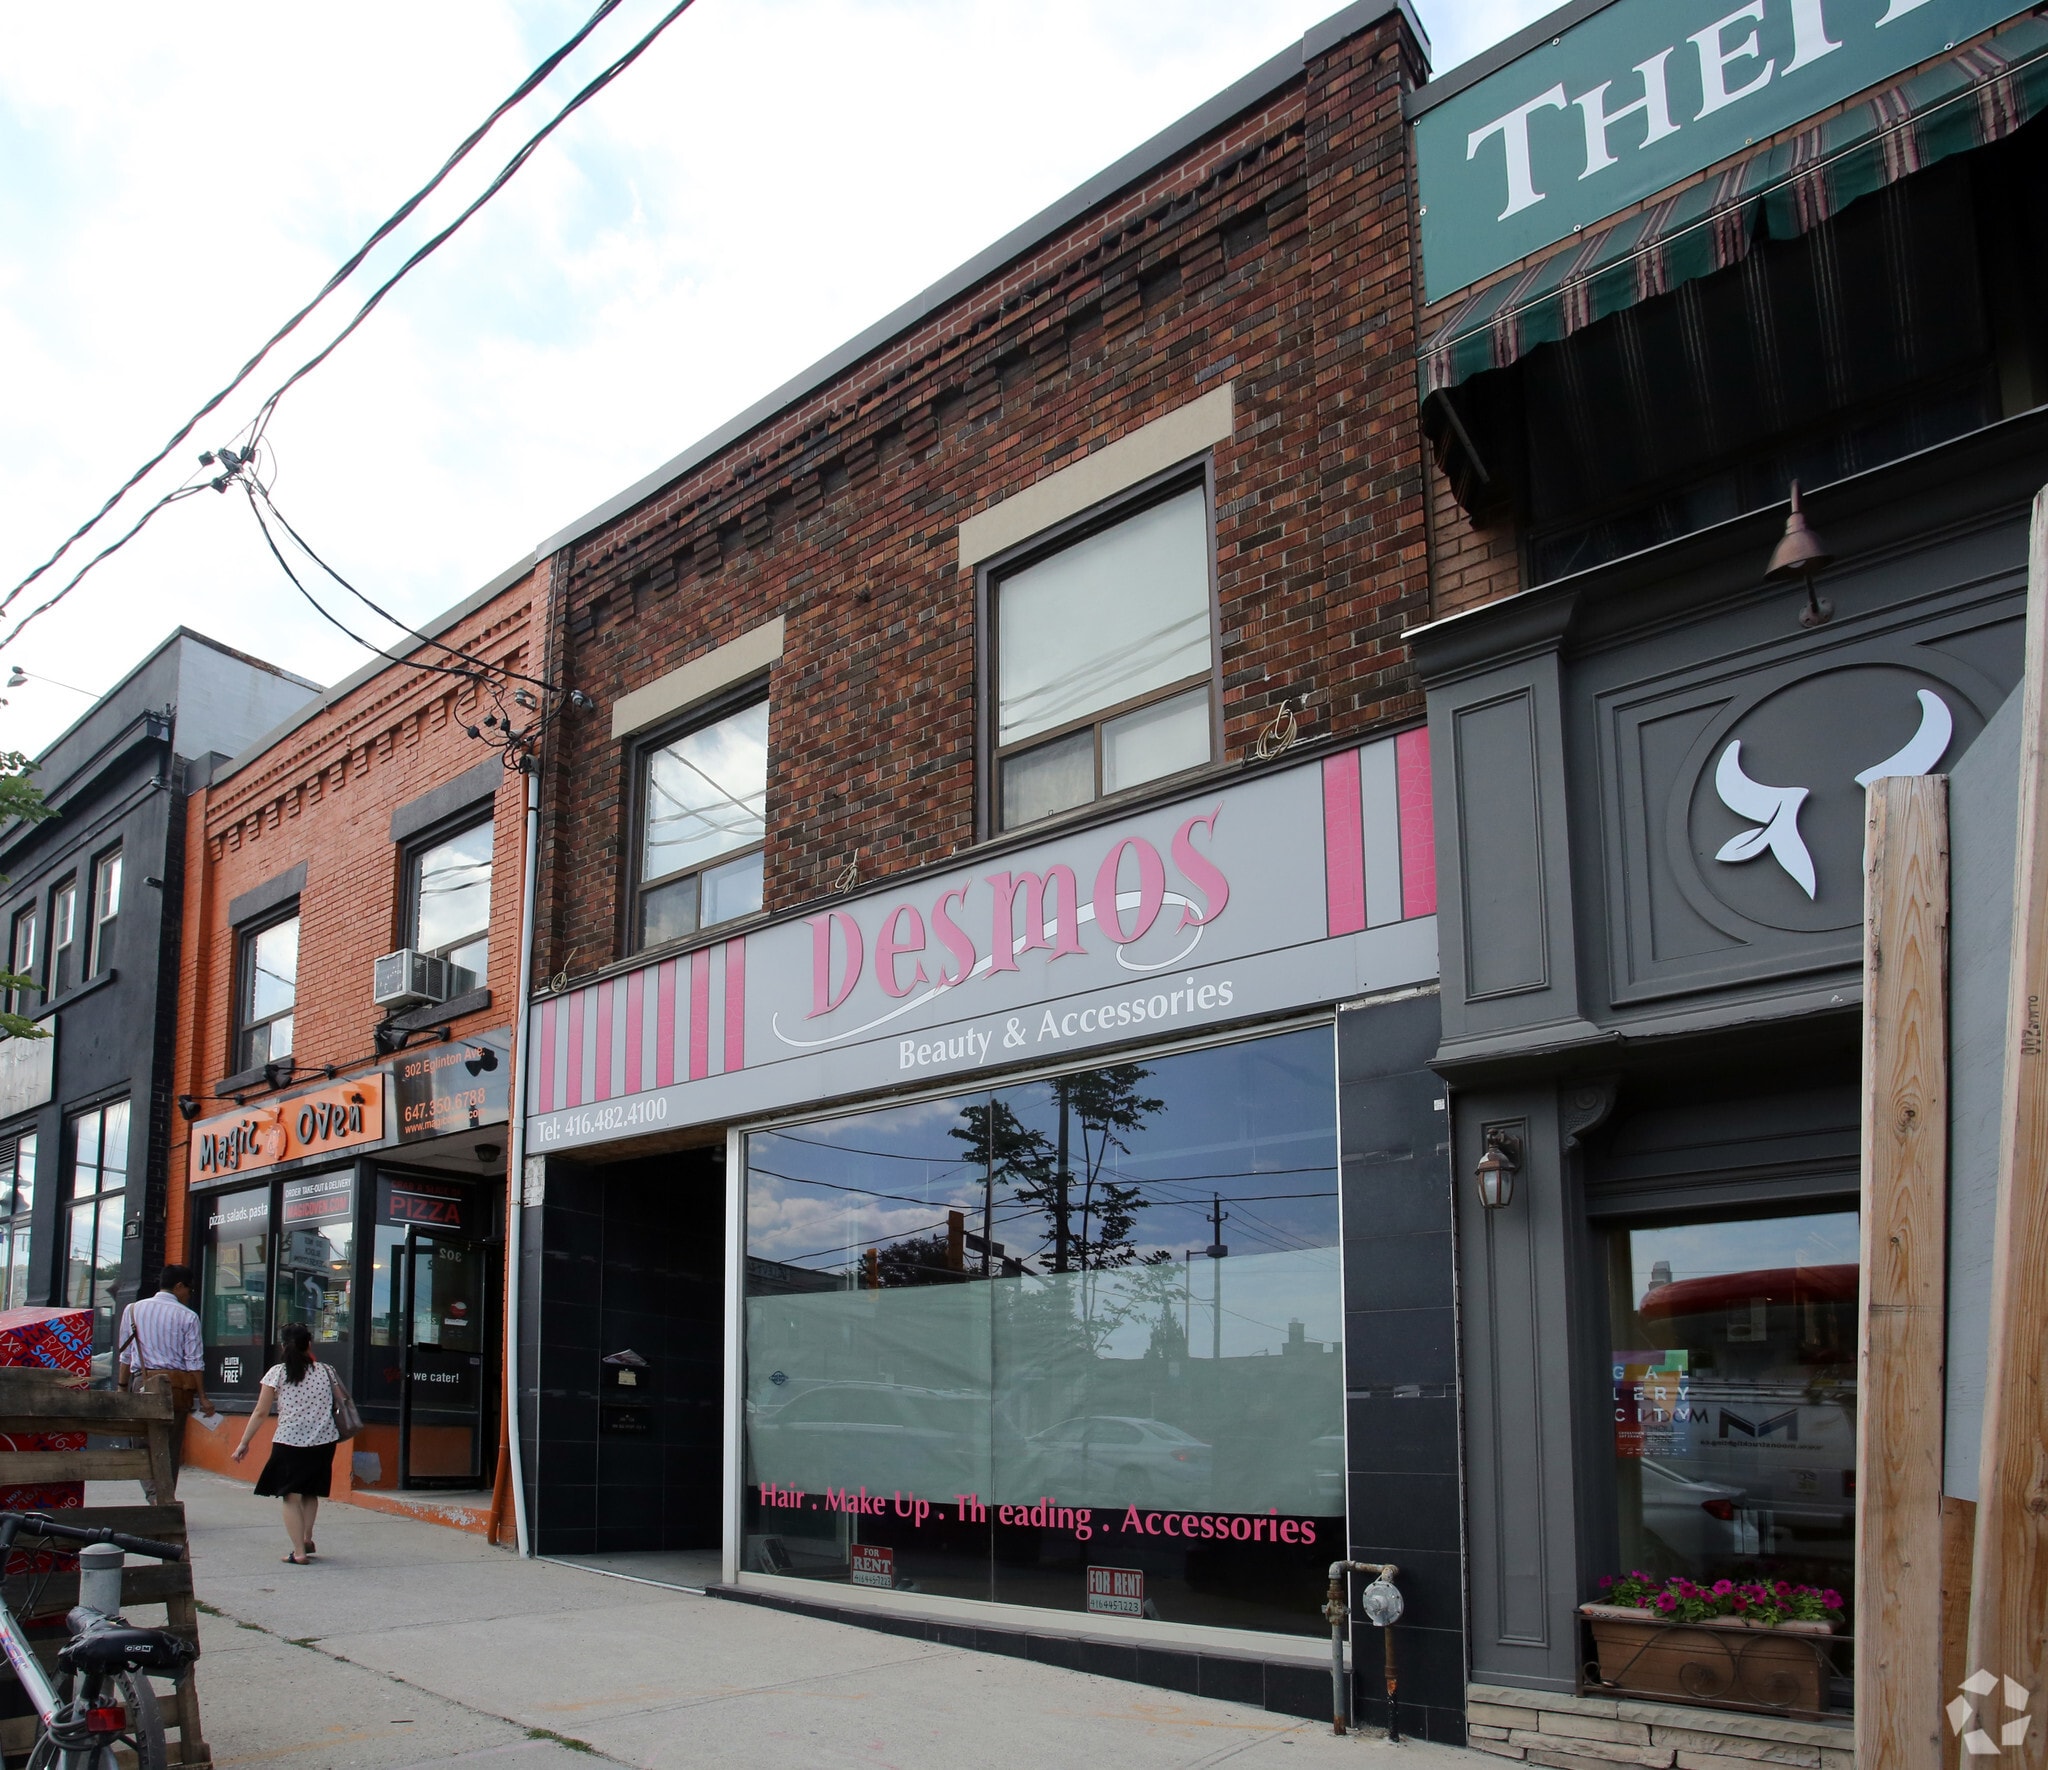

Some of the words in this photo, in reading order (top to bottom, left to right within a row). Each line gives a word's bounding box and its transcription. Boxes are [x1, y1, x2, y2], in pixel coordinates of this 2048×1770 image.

[899, 1027, 993, 1070] Beauty
[1002, 1016, 1027, 1049] &
[1037, 976, 1234, 1042] Accessories
[404, 1062, 422, 1078] 302
[423, 1052, 462, 1074] Eglinton
[464, 1046, 486, 1060] Ave.
[404, 1087, 486, 1122] 647.350.6788
[538, 1117, 561, 1142] Tel:
[564, 1097, 668, 1137] 416.482.4100
[200, 1119, 261, 1173] Magic
[296, 1101, 364, 1145] Oven
[285, 1187, 301, 1198] ORDER
[302, 1182, 324, 1195] TAKE-OUT
[329, 1178, 352, 1190] DELIVERY
[249, 1202, 268, 1222] pasta
[389, 1195, 461, 1225] PIZZA
[45, 1318, 83, 1352] M6S
[223, 1370, 239, 1384] FREE
[413, 1372, 427, 1381] we
[430, 1372, 459, 1384] cater!
[760, 1481, 805, 1510] Hair
[825, 1486, 886, 1516] Make
[894, 1491, 930, 1528] Up
[1120, 1503, 1317, 1545] Accessories
[853, 1556, 891, 1574] RENT
[863, 1547, 880, 1558] FOR
[1089, 1570, 1110, 1594] FOR
[1114, 1572, 1141, 1597] RENT
